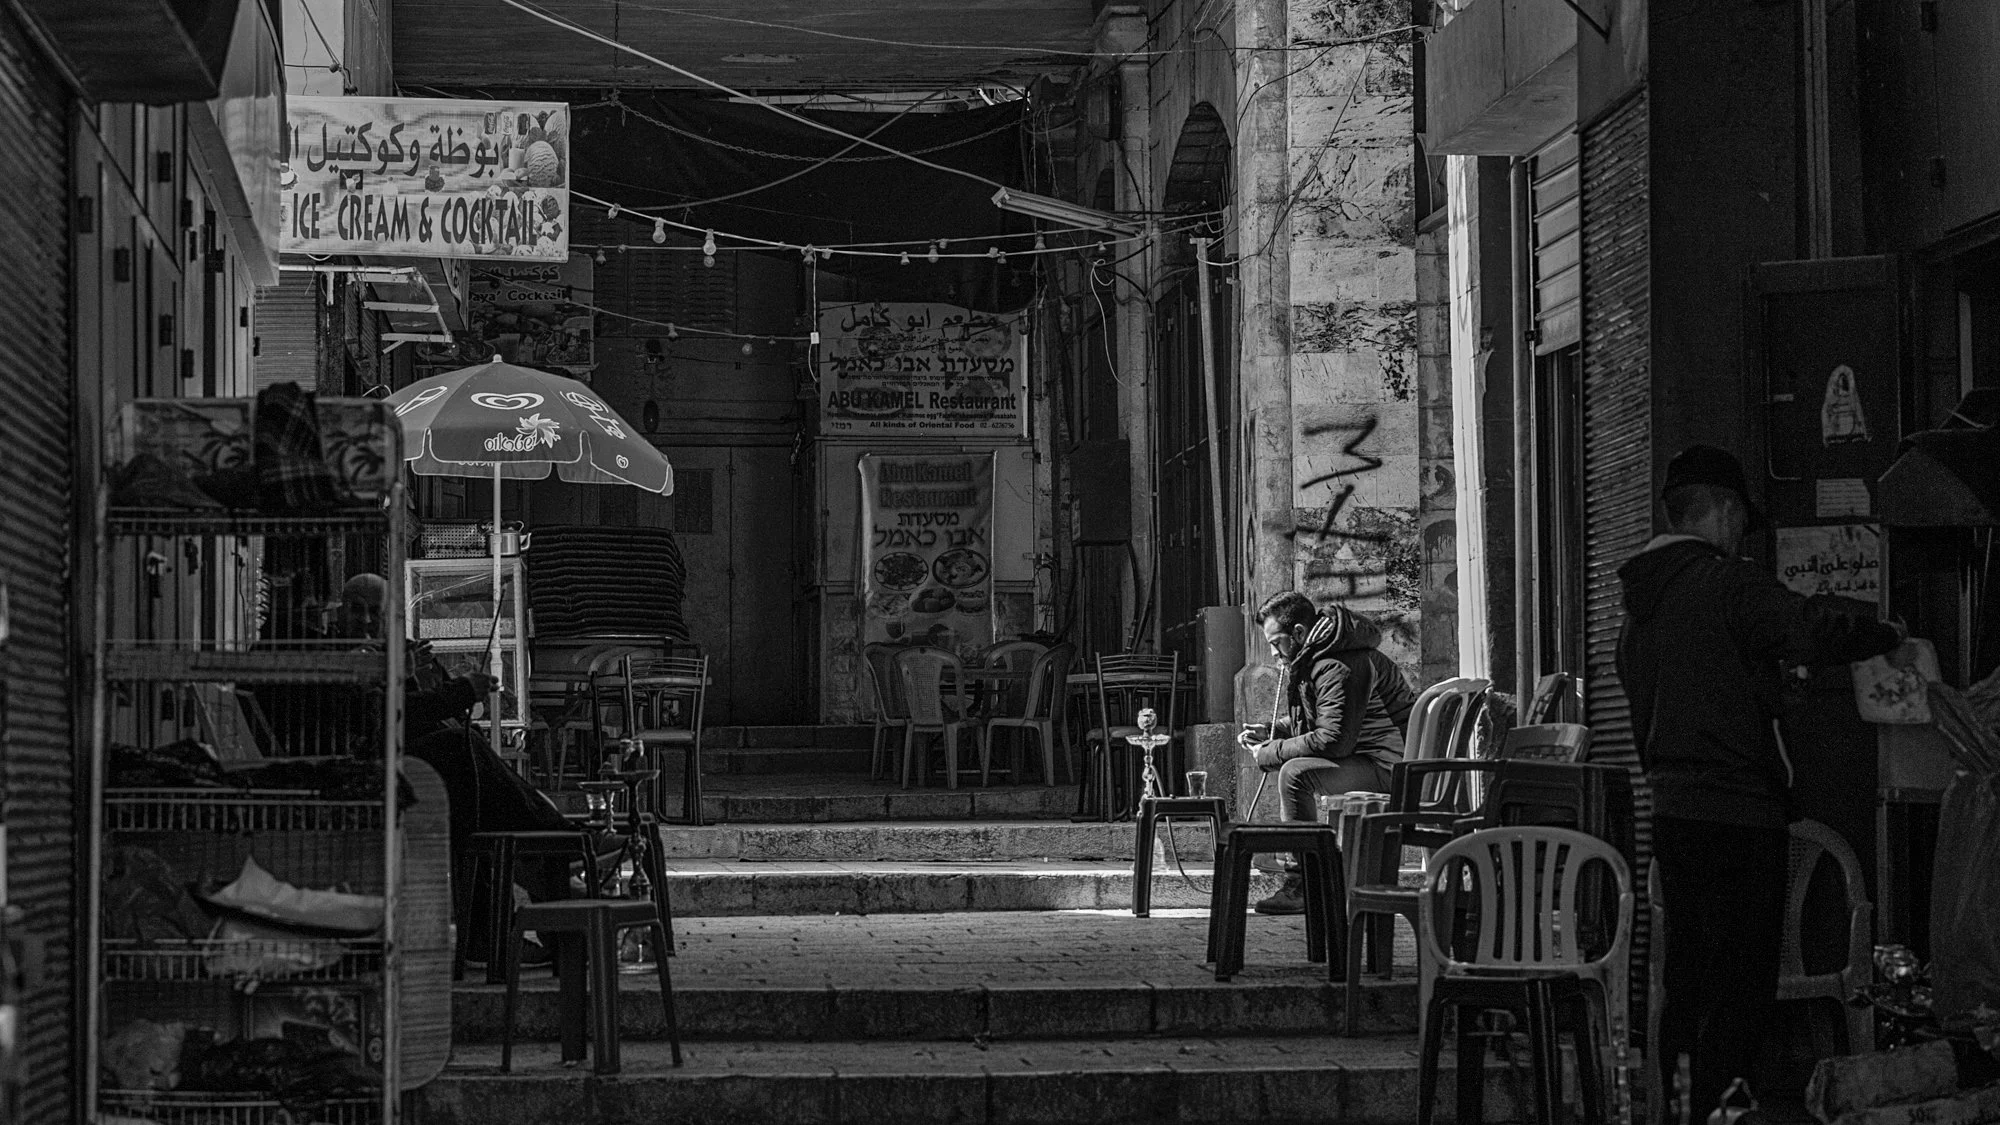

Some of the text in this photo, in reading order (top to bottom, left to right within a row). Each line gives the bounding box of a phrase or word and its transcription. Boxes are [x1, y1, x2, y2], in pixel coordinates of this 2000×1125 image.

[307, 121, 420, 176] وكوكتيل
[430, 125, 499, 178] بوظة
[293, 192, 537, 246] ICE CREAM & COCKTAIL
[841, 304, 999, 337] مطعم ابو كامل
[829, 352, 1014, 373] מסעדת אבו כאמל
[827, 391, 1016, 410] ABU KAMEL Restaurant
[869, 421, 881, 429] All
[883, 421, 906, 429] kinds
[907, 421, 917, 429] of
[919, 421, 951, 429] Oriental
[955, 421, 975, 429] Food
[880, 462, 973, 483] Abu Kamel
[880, 487, 977, 508] Restaurant
[897, 511, 960, 527] מסעדת
[874, 525, 985, 547] אבו כאמל
